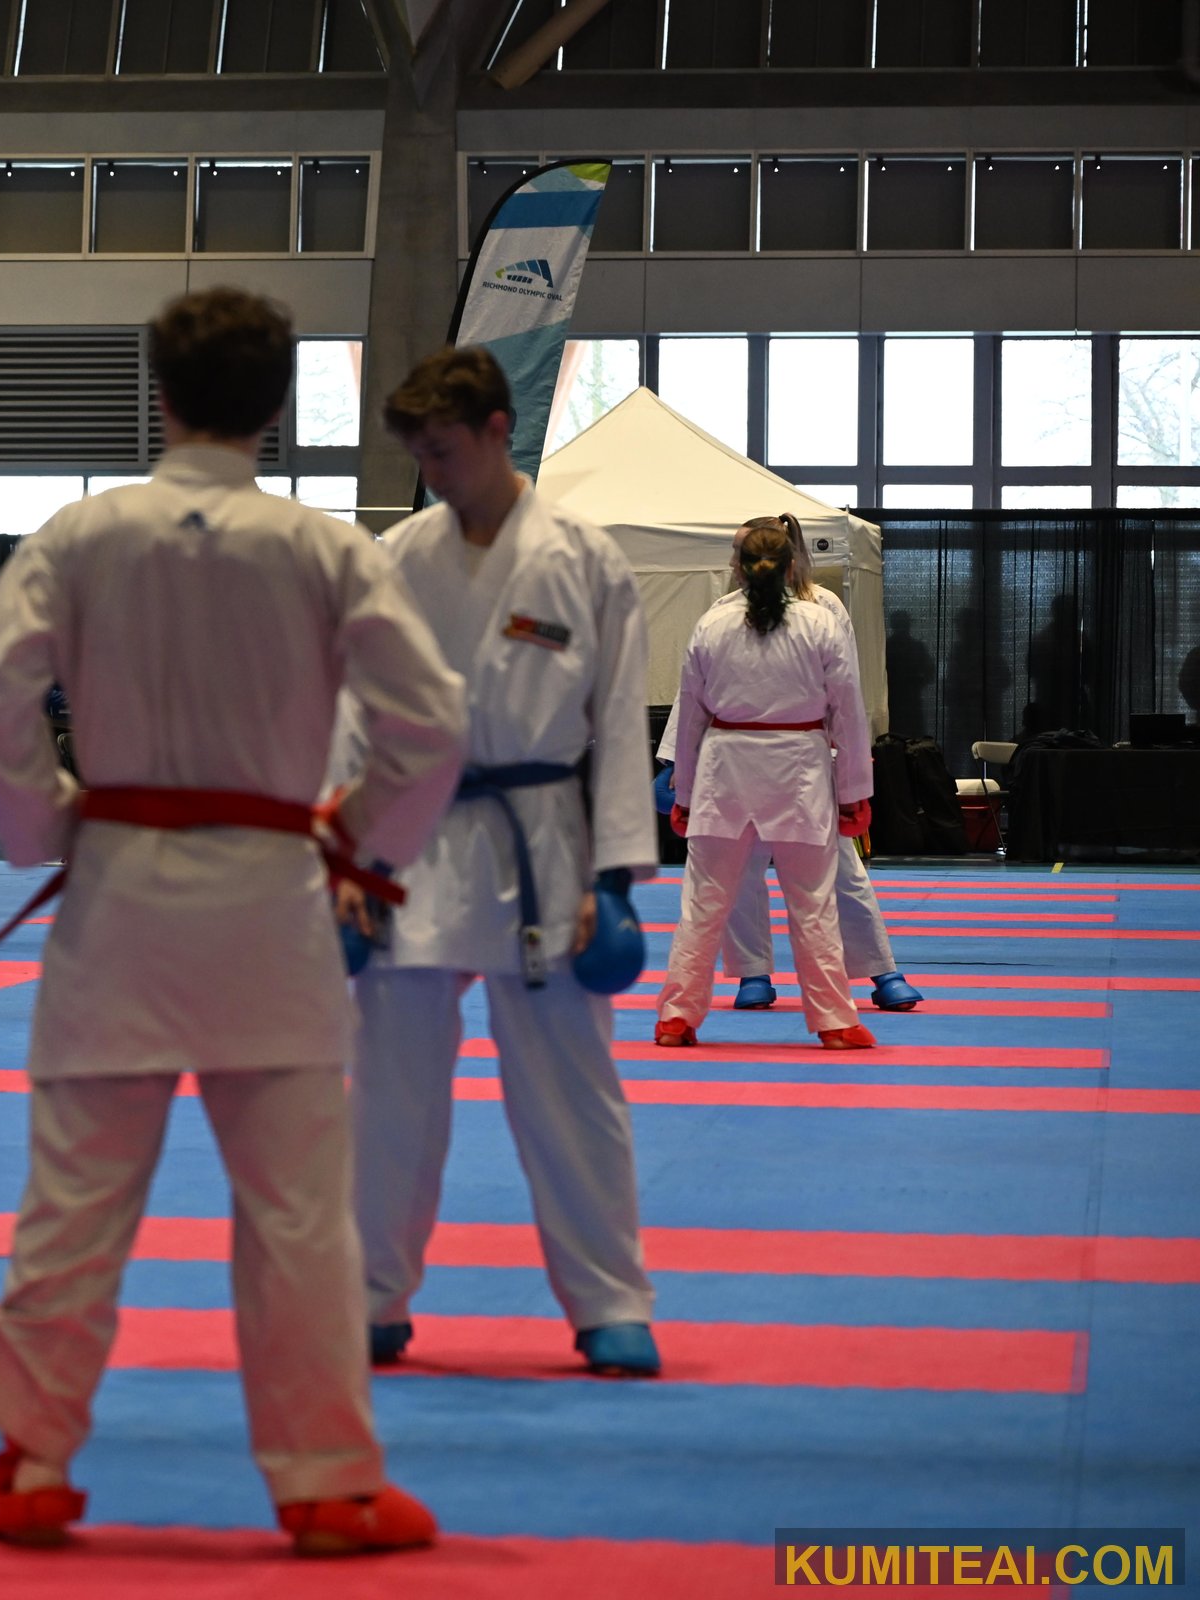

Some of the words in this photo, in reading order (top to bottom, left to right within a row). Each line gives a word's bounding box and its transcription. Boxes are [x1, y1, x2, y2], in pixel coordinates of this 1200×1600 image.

[482, 281, 517, 292] RICHMOND
[518, 287, 546, 298] OLYMPIC
[547, 293, 562, 301] OVAL
